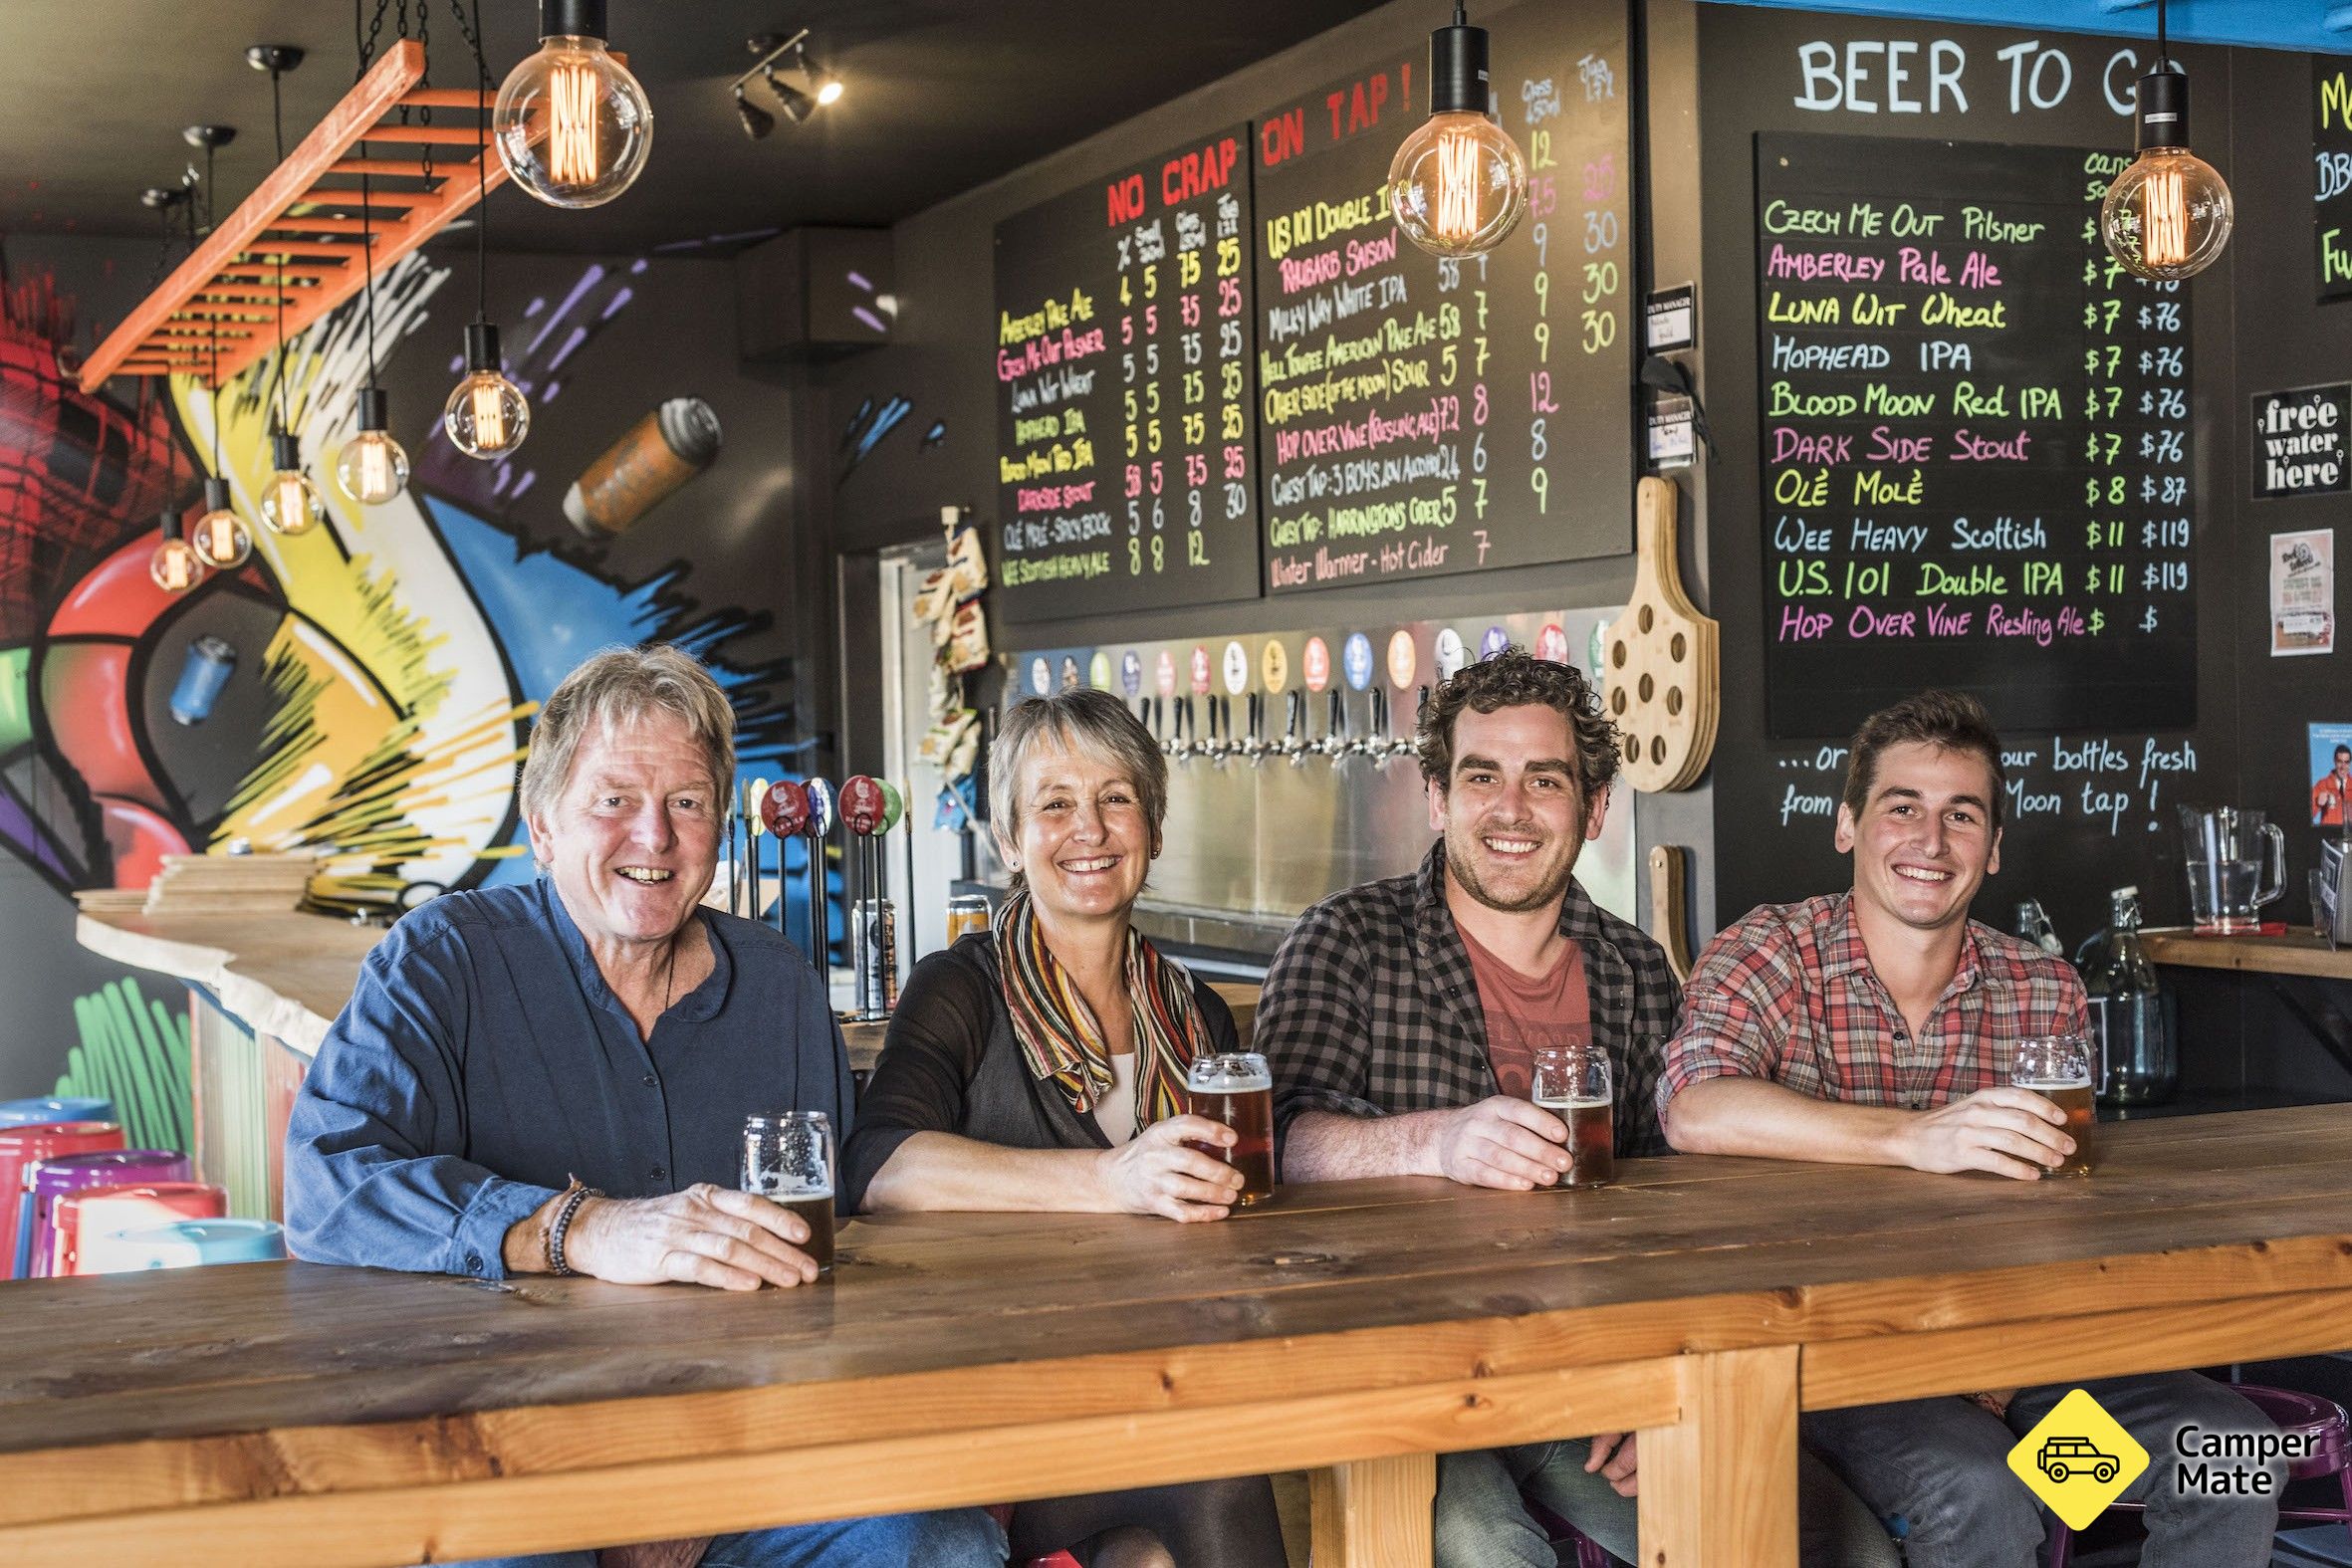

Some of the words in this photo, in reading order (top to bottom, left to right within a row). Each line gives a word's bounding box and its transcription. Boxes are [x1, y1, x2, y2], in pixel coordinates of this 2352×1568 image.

[1793, 40, 1969, 113] BEER
[1998, 40, 2071, 113] TO
[2103, 48, 2186, 115] G
[1263, 109, 1304, 166] ON
[1327, 74, 1388, 140] TAP
[1530, 129, 1557, 170] 12
[1107, 174, 1145, 227] NO
[1162, 137, 1237, 206] CRAP
[1533, 223, 1546, 267] 9
[1583, 211, 1618, 254] 30
[1764, 200, 1840, 235] CZECH
[1962, 206, 2044, 244] Pilsner
[1144, 265, 1157, 299] 5
[1767, 244, 1885, 283] AMBERLEY
[1899, 248, 1952, 285] Pale
[1960, 251, 2001, 289] Ale
[1474, 290, 1489, 331] 7
[1534, 272, 1547, 317] 9
[1581, 262, 1617, 304] 30
[1767, 292, 1840, 325] LUNA
[1921, 292, 2006, 328] Wheat
[2136, 302, 2182, 332] $76
[1121, 316, 1133, 345] 5
[1145, 305, 1157, 336] 5
[1123, 352, 1135, 383] 5
[1146, 343, 1159, 375] 5
[1440, 343, 1457, 386] 5
[1474, 336, 1491, 376] 7
[1534, 323, 1548, 363] 9
[1581, 311, 1616, 353] 30
[1772, 333, 1890, 371] HOPHEAD
[1920, 340, 1972, 371] IPA
[2138, 345, 2184, 377] $76
[1124, 389, 1138, 422] 5
[1146, 381, 1160, 414] 5
[1473, 383, 1488, 426] 8
[1530, 370, 1559, 413] 12
[1768, 381, 1857, 417] BLOOD
[1864, 383, 1935, 416] MOON
[1953, 381, 2008, 418] Red
[2020, 387, 2062, 420] IPA
[2138, 388, 2187, 420] $76
[2265, 398, 2338, 434] free
[1125, 424, 1138, 458] 5
[1148, 418, 1162, 453] 5
[1474, 432, 1487, 473] 6
[1530, 418, 1546, 461] 8
[1771, 427, 1853, 464] DARK
[1866, 426, 1933, 463] SIDE
[1950, 429, 2031, 462] Stout
[2139, 430, 2185, 464] $76
[2265, 430, 2339, 458] water
[1150, 461, 1163, 495] 5
[1441, 485, 1457, 525] 5
[1473, 479, 1488, 520] 7
[1530, 467, 1548, 514] 9
[2140, 474, 2187, 506] $87
[2265, 459, 2339, 491] here
[1128, 500, 1140, 536] 5
[1152, 498, 1164, 530] 6
[1188, 490, 1202, 528] 8
[1223, 482, 1247, 520] 30
[1128, 537, 1142, 576] 8
[1150, 535, 1164, 573] 8
[1188, 530, 1211, 567] 12
[1380, 541, 1405, 574] Hot
[1407, 535, 1449, 570] Cider
[1473, 530, 1491, 564] 7
[1774, 515, 1833, 553] WEE
[1850, 517, 1929, 554] HEAVY
[1951, 517, 2046, 550] Scottish
[2142, 520, 2189, 549] $119
[1915, 561, 2007, 597] Double
[2023, 562, 2063, 595] IPA
[2142, 562, 2188, 591] $119
[1778, 605, 1833, 646] HOP
[1848, 603, 1915, 637] OVER
[1927, 602, 1972, 637] VINE
[1986, 602, 2053, 647] Riesling
[2057, 606, 2085, 636] Ale
[2000, 751, 2038, 768] our
[2053, 736, 2129, 773] bottles
[2140, 738, 2197, 790] fresh
[1780, 784, 1832, 826] from
[2081, 781, 2129, 836] tap
